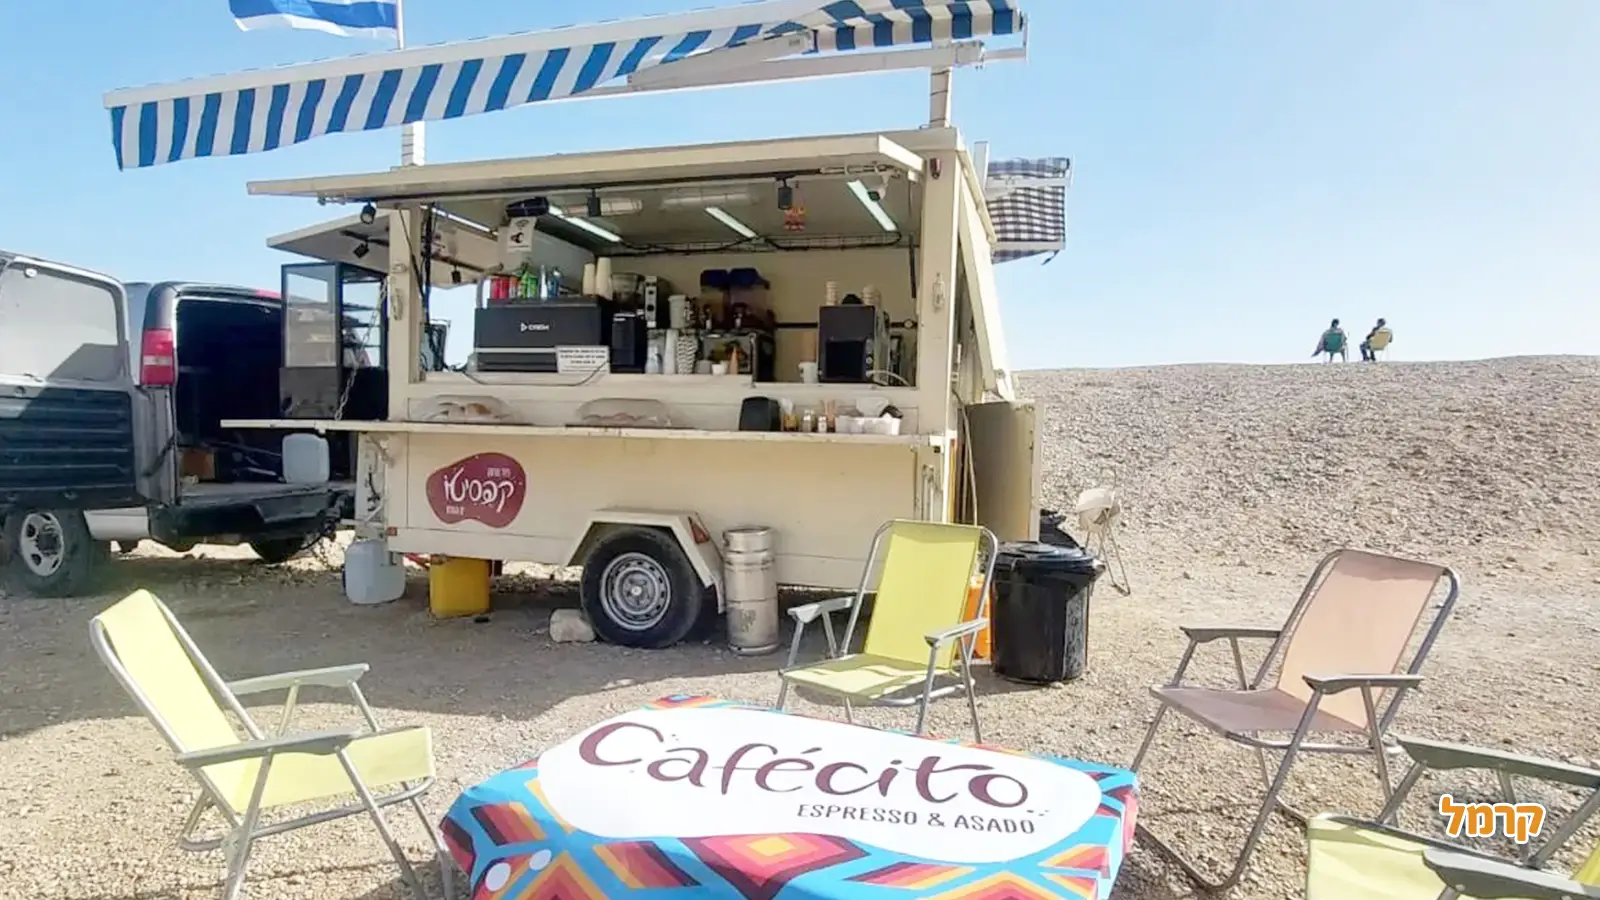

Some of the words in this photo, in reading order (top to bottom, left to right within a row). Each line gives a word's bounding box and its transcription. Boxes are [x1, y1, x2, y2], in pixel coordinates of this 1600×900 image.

[578, 721, 1030, 808] Cafécito
[797, 803, 918, 826] ESPRESSO
[926, 811, 946, 828] &
[953, 814, 1036, 835] ASADO
